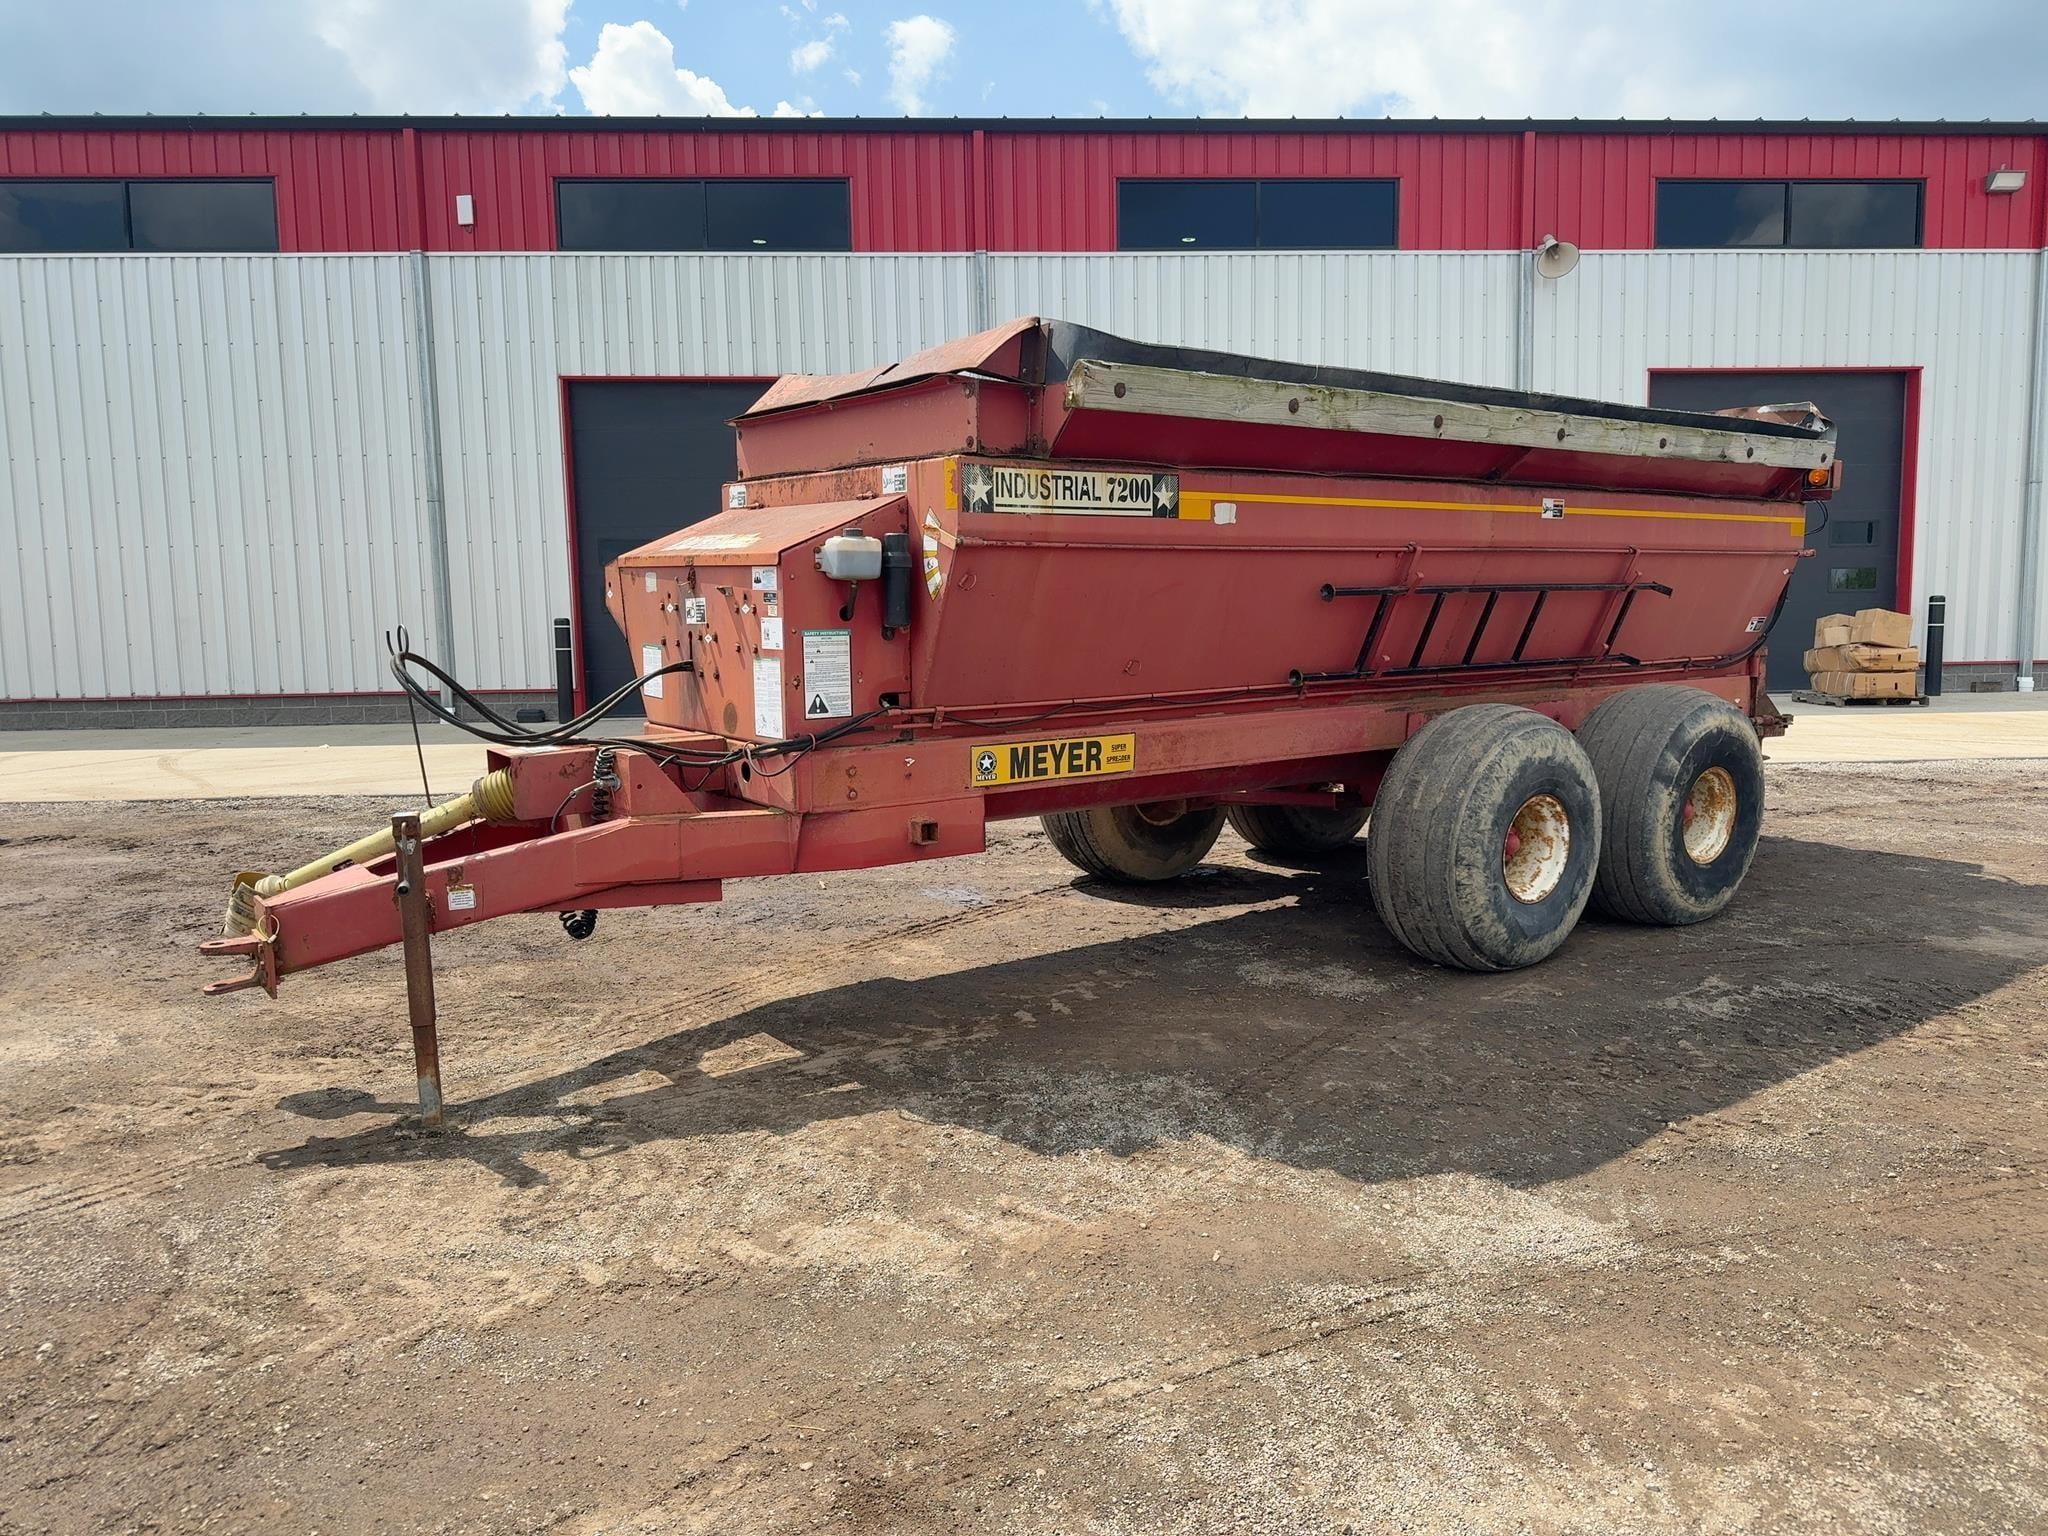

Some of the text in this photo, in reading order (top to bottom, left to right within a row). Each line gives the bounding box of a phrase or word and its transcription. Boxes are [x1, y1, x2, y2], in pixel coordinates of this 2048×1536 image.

[995, 472, 1151, 504] INDUSTRIAL 7200
[1010, 741, 1102, 778] MEYER
